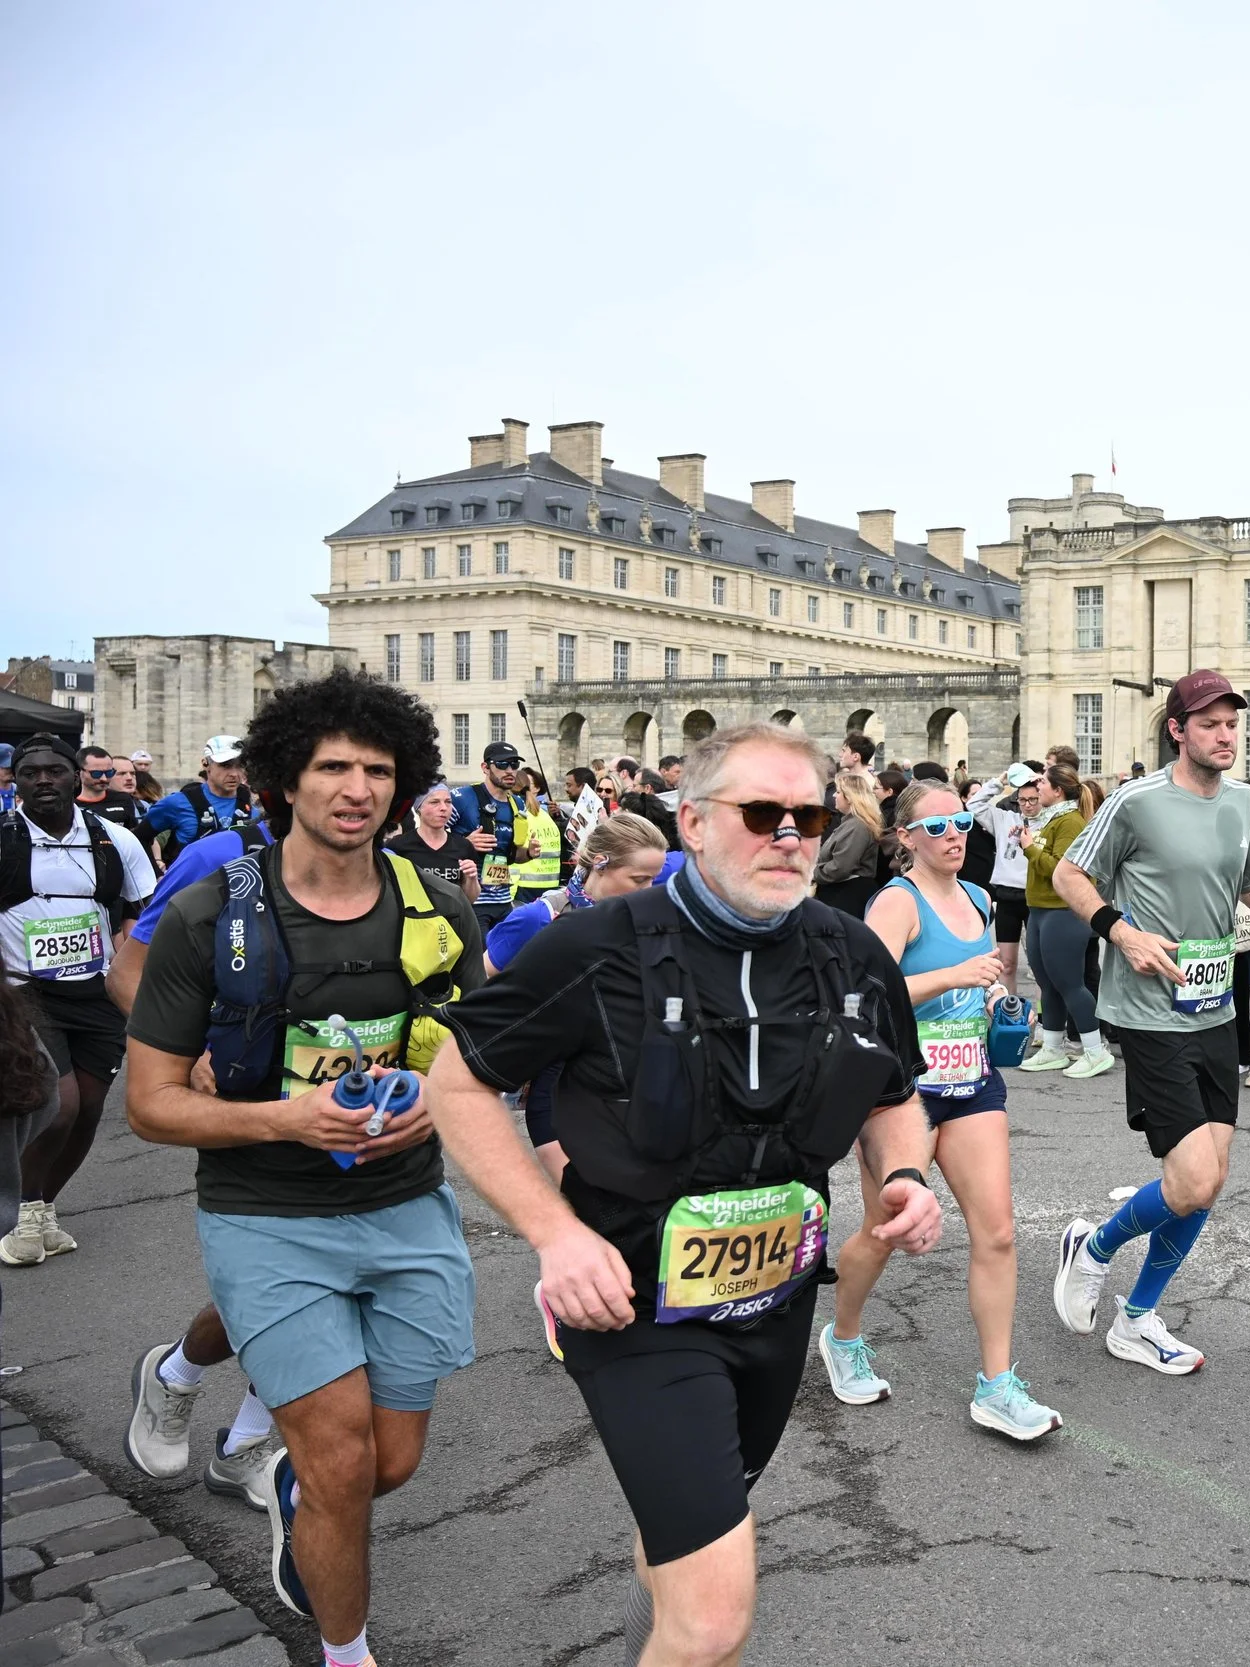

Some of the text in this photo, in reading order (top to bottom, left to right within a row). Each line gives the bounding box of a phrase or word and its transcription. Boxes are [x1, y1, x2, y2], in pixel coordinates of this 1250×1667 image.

[34, 918, 83, 930] Schneider
[34, 933, 88, 958] 28352
[230, 919, 246, 972] Oxsitis
[438, 924, 448, 962] xsitis
[1188, 941, 1228, 953] Schneider
[1185, 960, 1227, 986] 48019
[928, 1020, 975, 1032] Schneider
[347, 1033, 395, 1046] Eectric
[927, 1042, 979, 1070] 39901
[939, 1072, 967, 1081] BETHANY
[689, 1190, 792, 1214] Schneider
[734, 1204, 787, 1222] Electric
[680, 1226, 788, 1280] 27914
[800, 1225, 819, 1269] 3H45
[711, 1278, 757, 1296] JOSEPH
